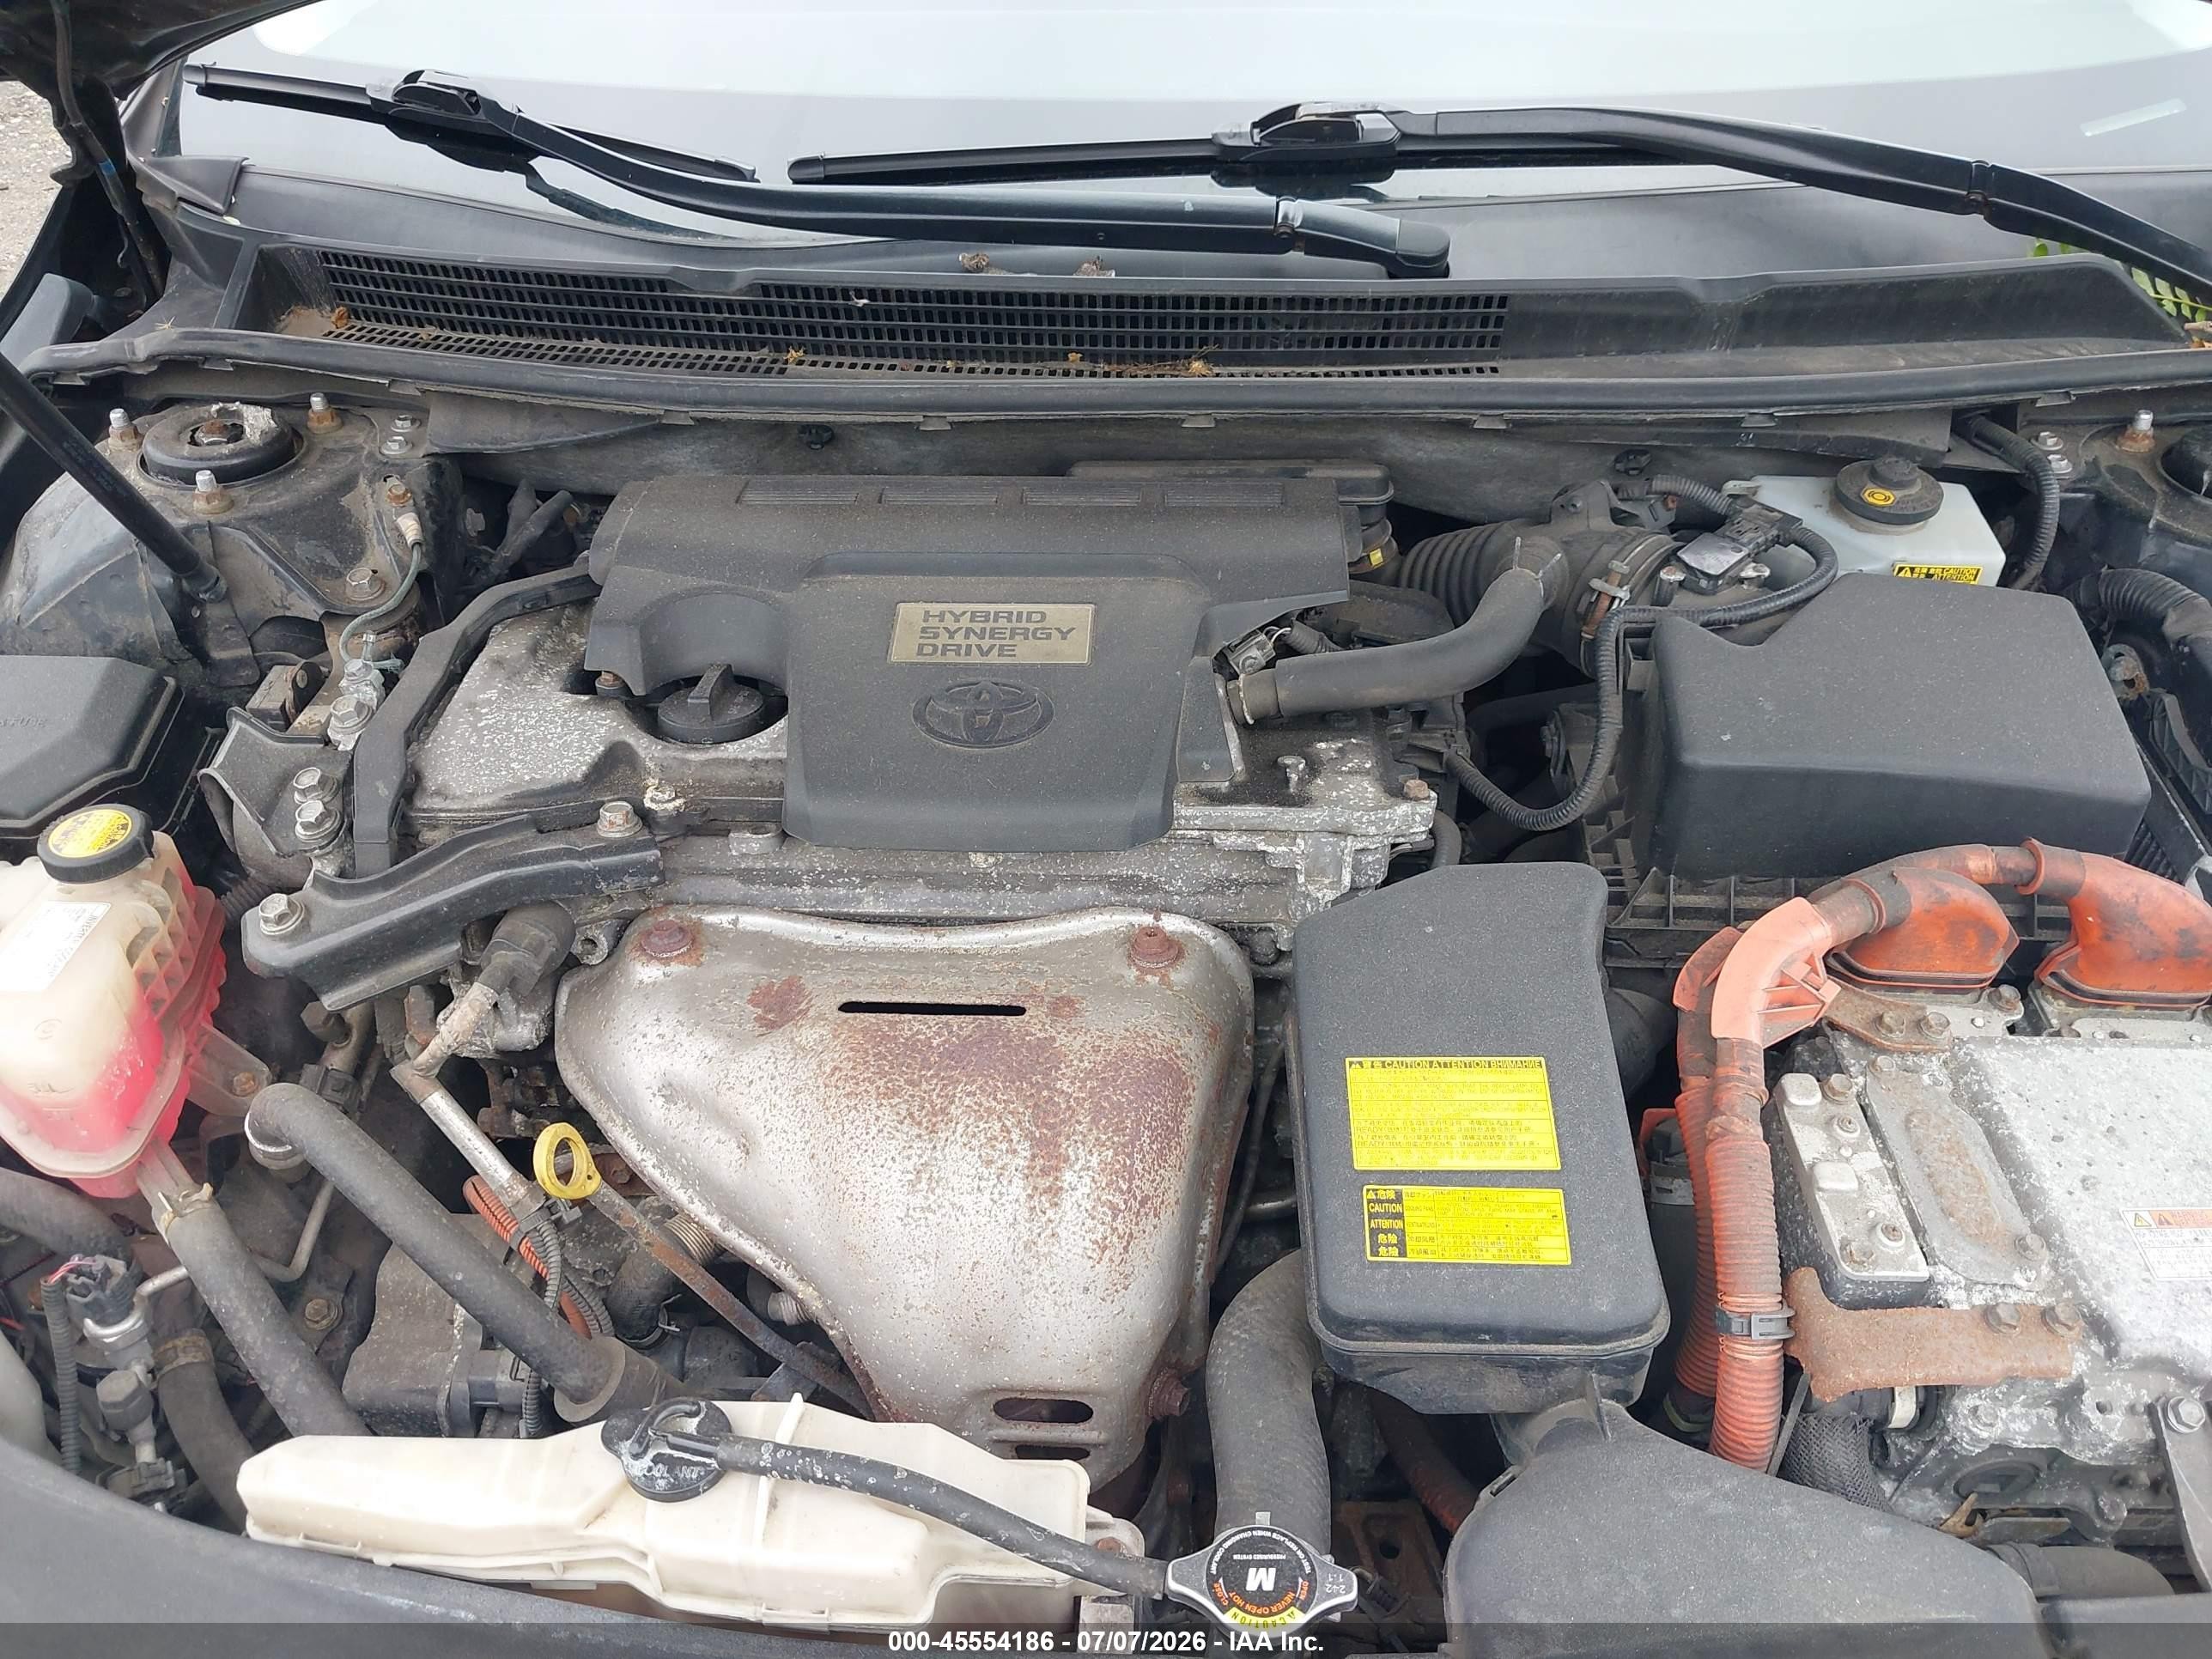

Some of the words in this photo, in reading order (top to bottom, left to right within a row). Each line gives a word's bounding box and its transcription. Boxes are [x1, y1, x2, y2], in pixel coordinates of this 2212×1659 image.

[921, 610, 1047, 623] HYBRID
[919, 627, 1076, 641] SYNERGY
[915, 643, 1017, 658] DRIVE
[1369, 1202, 1402, 1212] CAUTION
[1370, 1219, 1403, 1230] ATTENTION
[1272, 1532, 1298, 1552] REPLACE
[1209, 1547, 1224, 1575] COOLANT
[1245, 1567, 1276, 1591] M
[1228, 1590, 1244, 1607] HOT
[1299, 1580, 1309, 1601] OPEN
[1245, 1603, 1269, 1614] OPEN
[1271, 1591, 1295, 1613] NEVER
[1231, 1612, 1286, 1628] CAUTION
